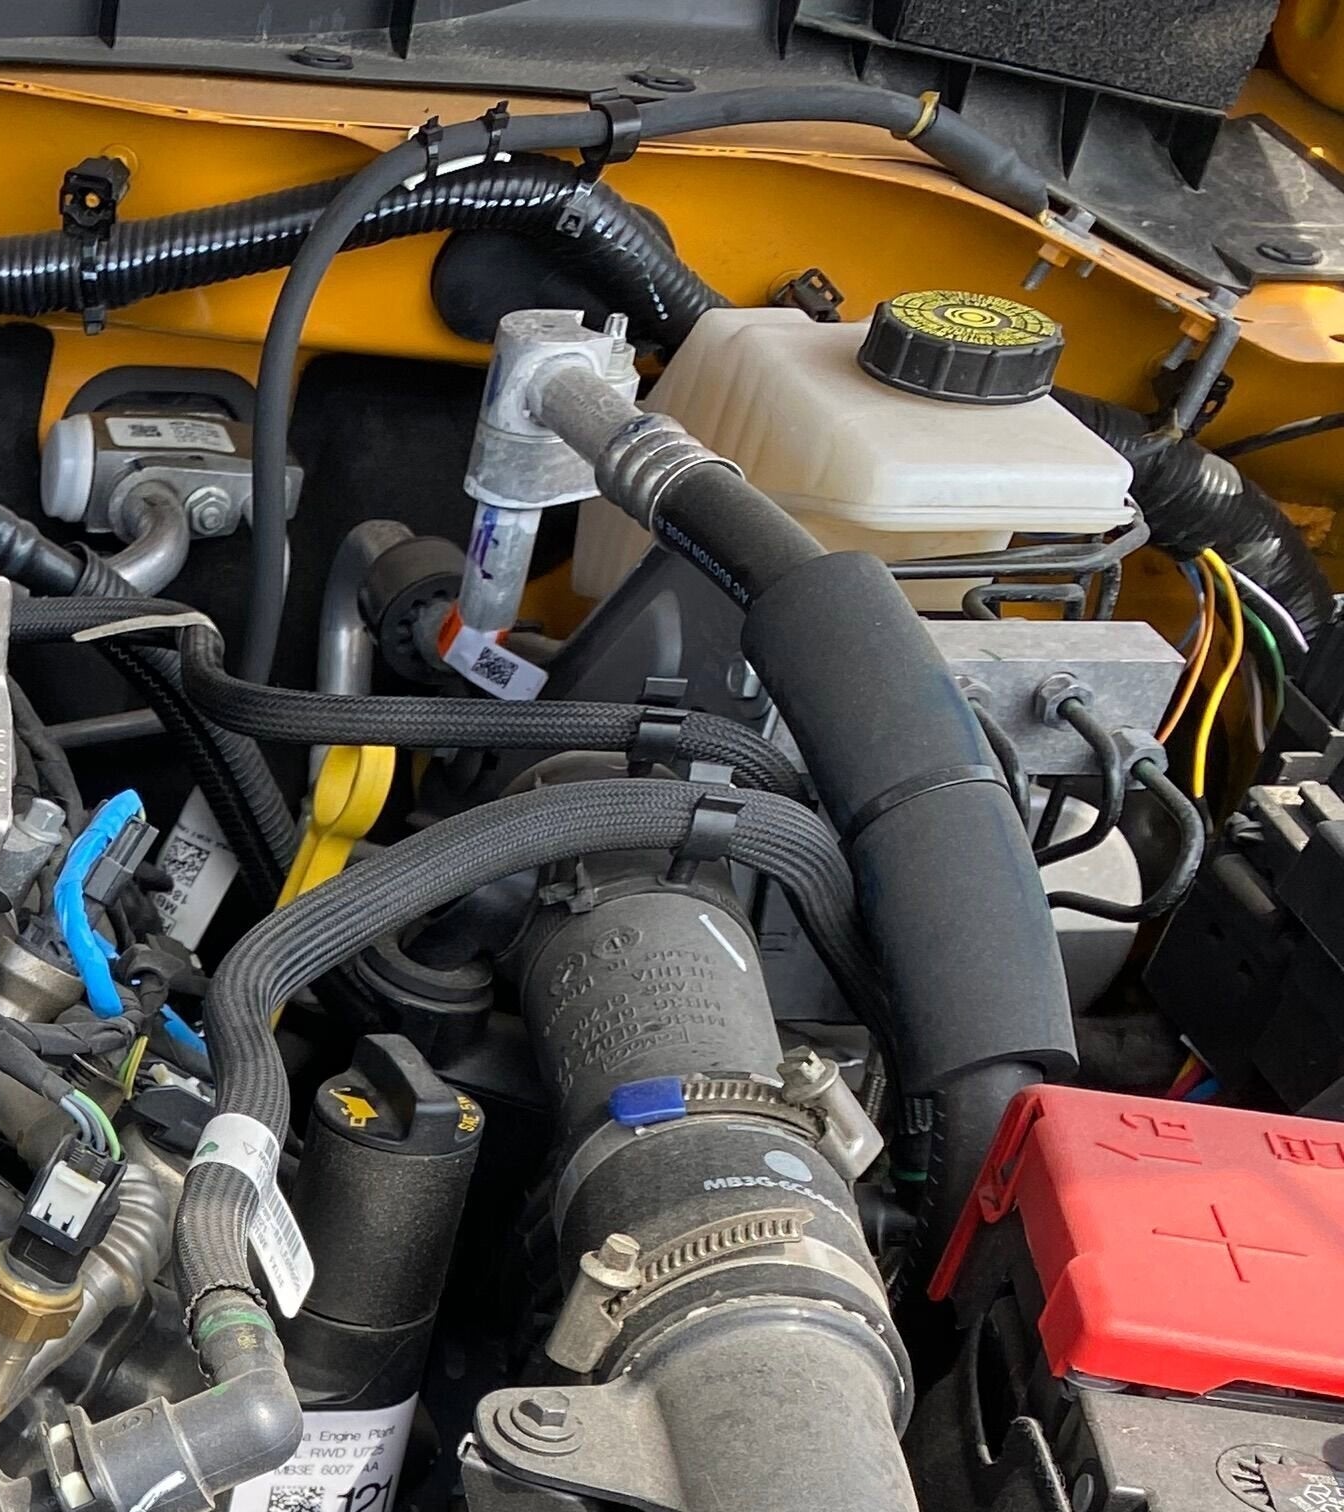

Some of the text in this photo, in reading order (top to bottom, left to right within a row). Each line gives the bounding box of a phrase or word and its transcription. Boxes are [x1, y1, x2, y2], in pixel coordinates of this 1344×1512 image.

[319, 1429, 362, 1443] Engine
[310, 1446, 347, 1459] RWD
[321, 1464, 354, 1476] 6007
[362, 1461, 380, 1473] AA
